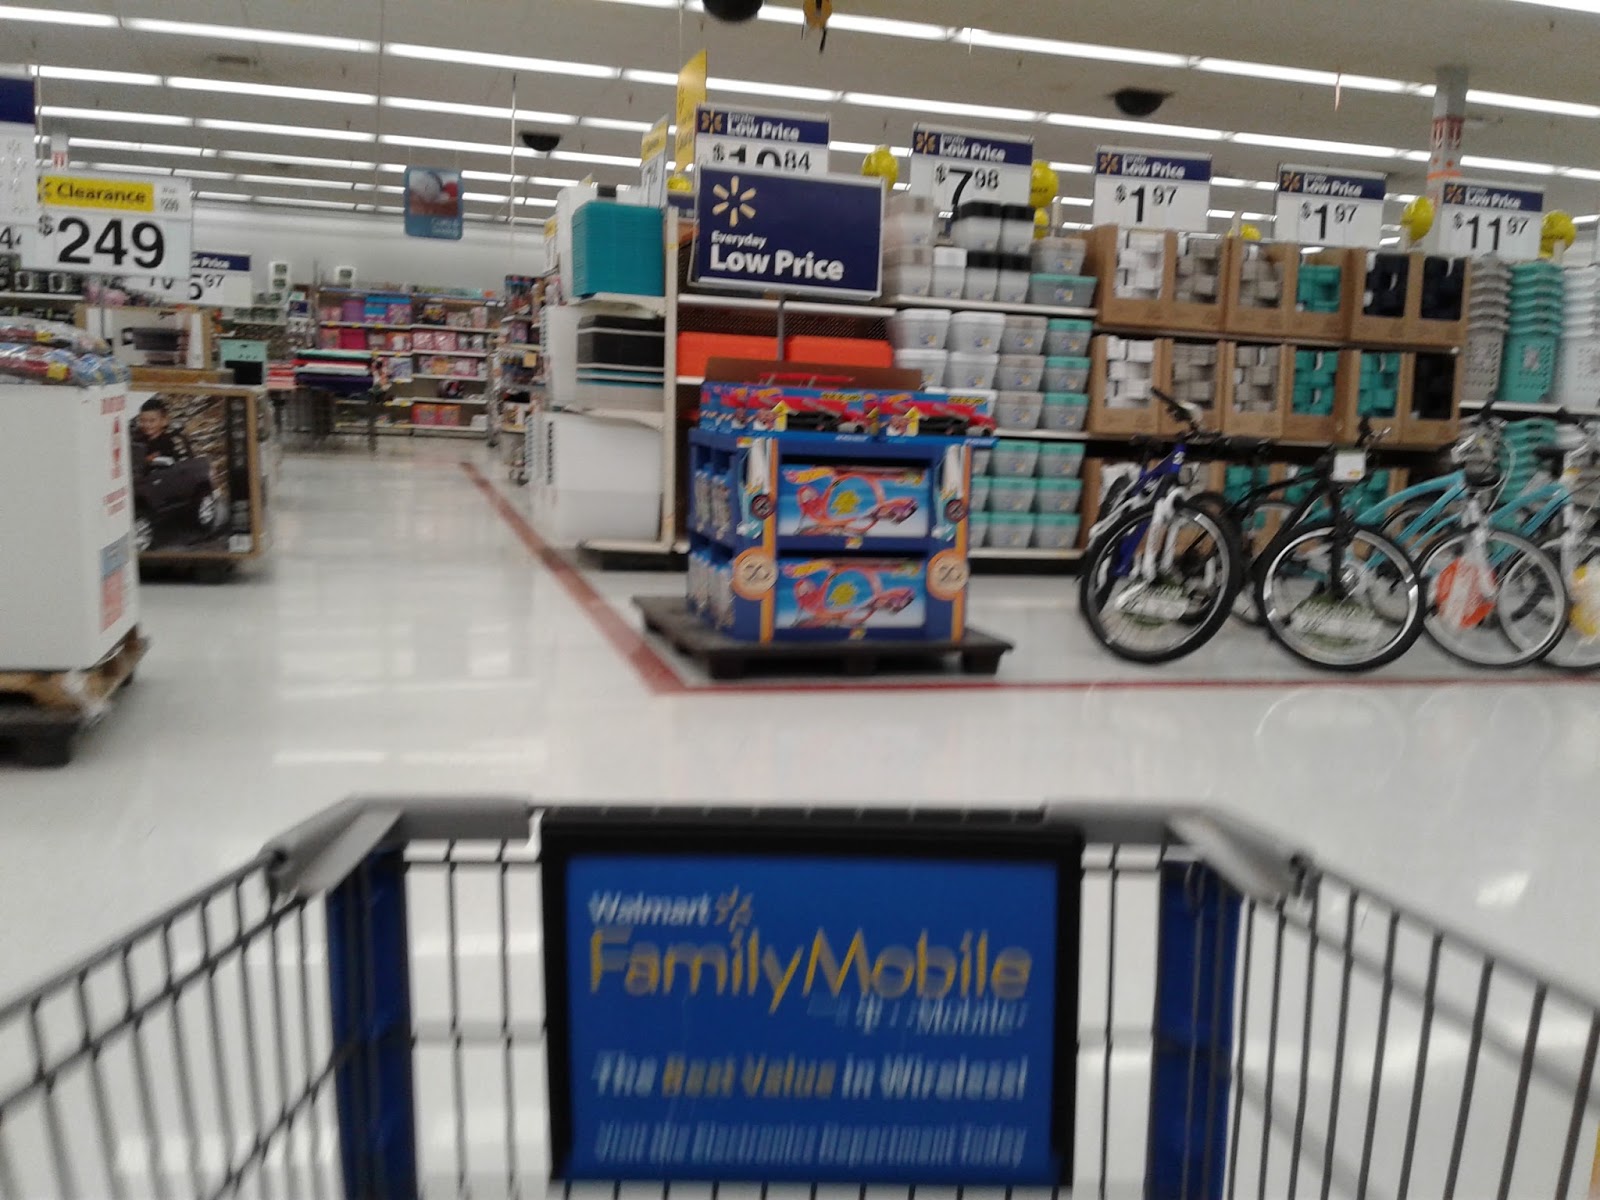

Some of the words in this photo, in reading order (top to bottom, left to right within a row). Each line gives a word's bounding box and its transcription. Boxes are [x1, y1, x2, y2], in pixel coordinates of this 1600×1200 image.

[727, 115, 759, 138] Low
[761, 121, 800, 142] Price
[970, 142, 1006, 162] Price
[56, 181, 147, 204] Clearance
[711, 230, 767, 250] Everyday
[710, 244, 770, 273] Low
[774, 248, 844, 282] Price
[588, 890, 711, 927] Walmart
